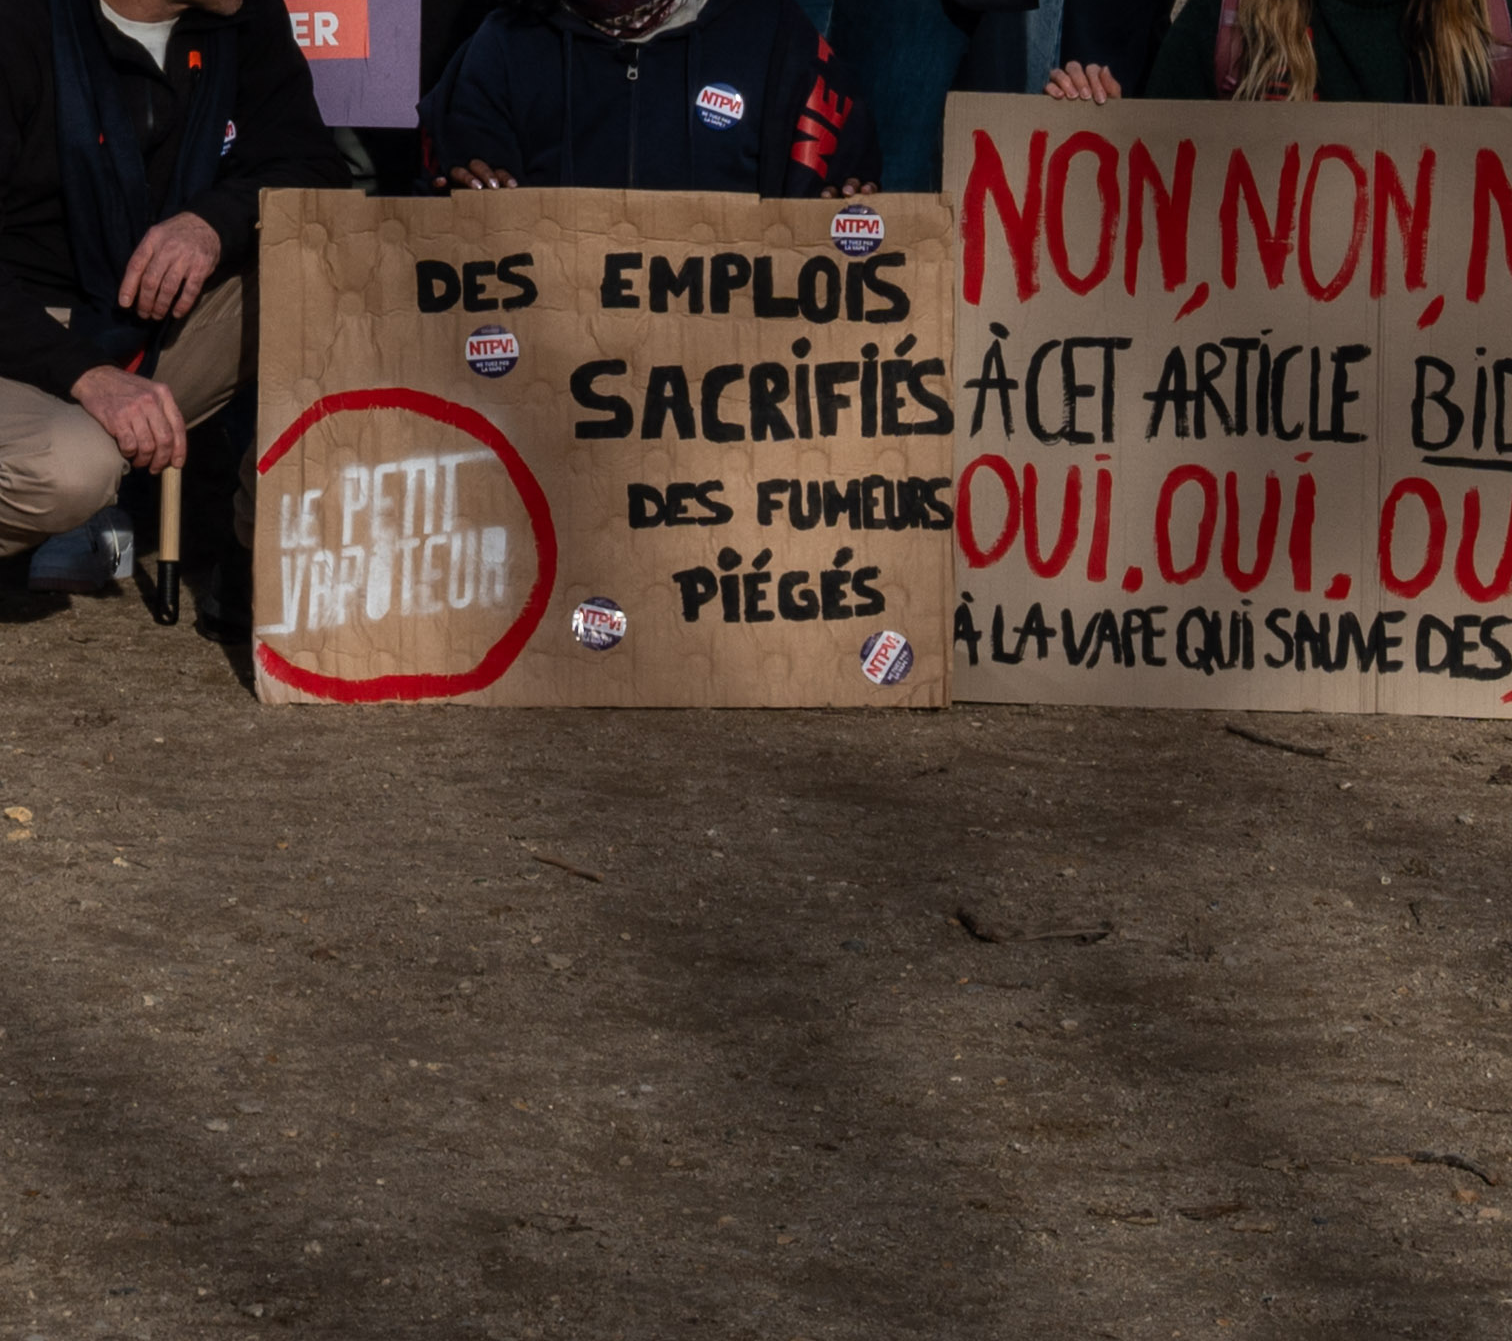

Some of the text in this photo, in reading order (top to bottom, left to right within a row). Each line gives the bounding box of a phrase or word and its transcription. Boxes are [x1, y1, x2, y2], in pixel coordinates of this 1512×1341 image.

[834, 216, 882, 235] NTPV!
[415, 251, 911, 325] DES EMPLOIS
[468, 339, 516, 358] NTPV!
[1142, 336, 1372, 444] ARTICLE
[626, 474, 955, 532] DES FUMEURS
[990, 602, 1057, 666] LA
[1060, 605, 1169, 670] VAPE
[1175, 598, 1255, 677] QUI
